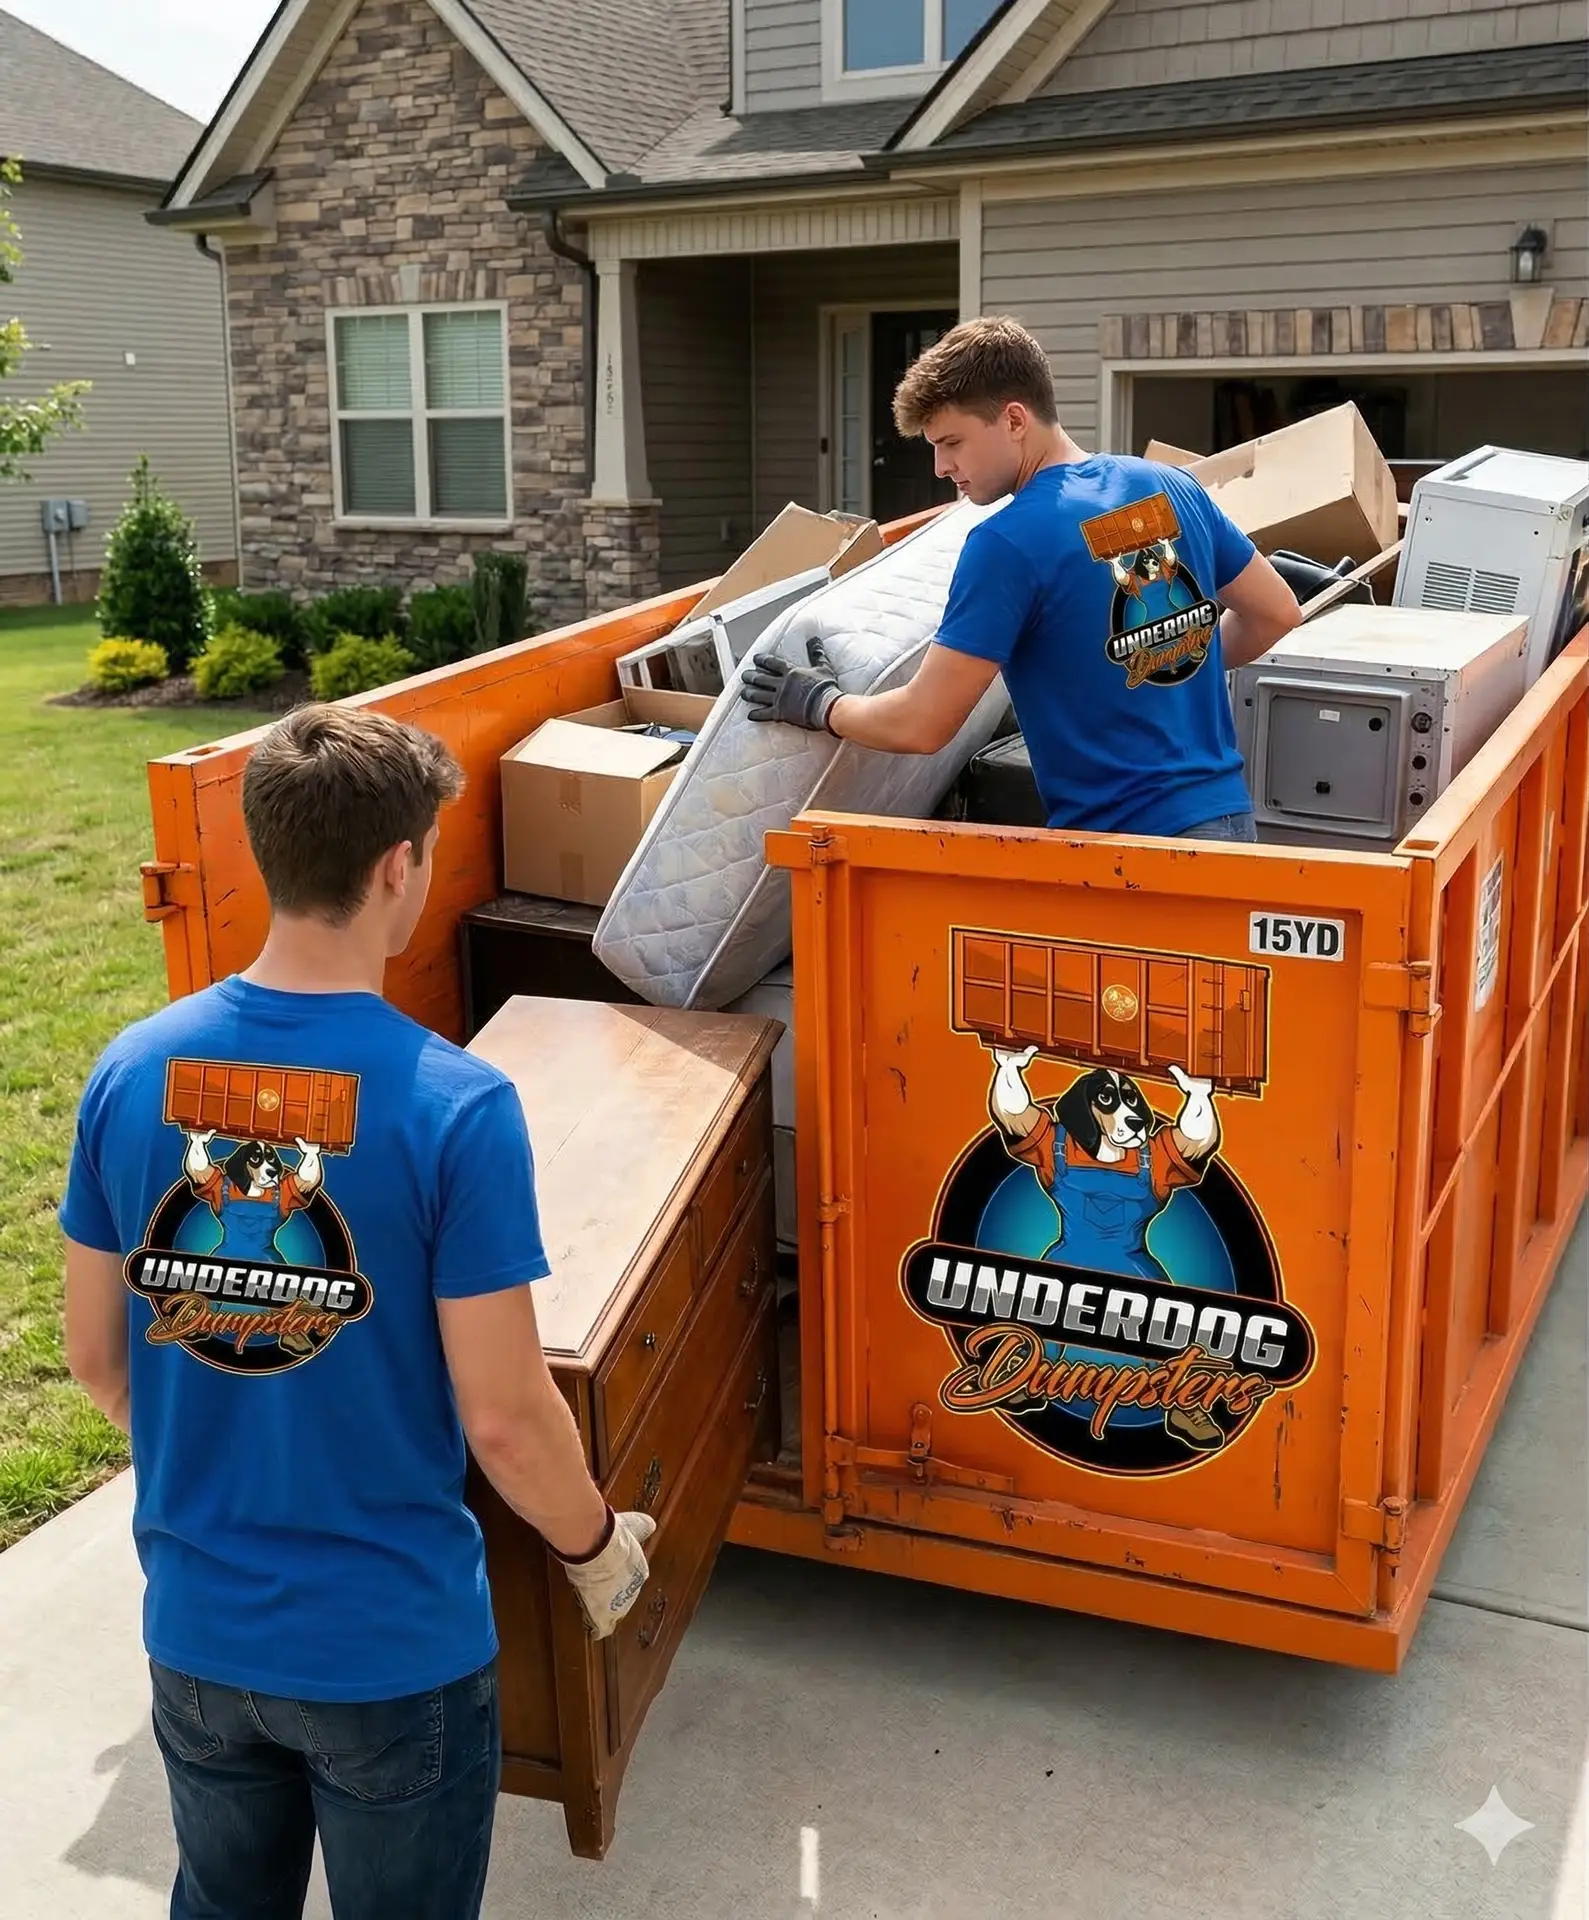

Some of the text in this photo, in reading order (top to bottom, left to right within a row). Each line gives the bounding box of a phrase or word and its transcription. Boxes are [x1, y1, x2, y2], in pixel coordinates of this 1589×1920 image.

[1113, 603, 1213, 659] UNDERDOG
[1252, 918, 1340, 957] 15YD
[141, 1257, 355, 1310] UNDERDOG
[926, 1258, 1289, 1368] UNDERDOG
[146, 1292, 340, 1354] Dumpsters
[941, 1326, 1272, 1438] Dumpsters
